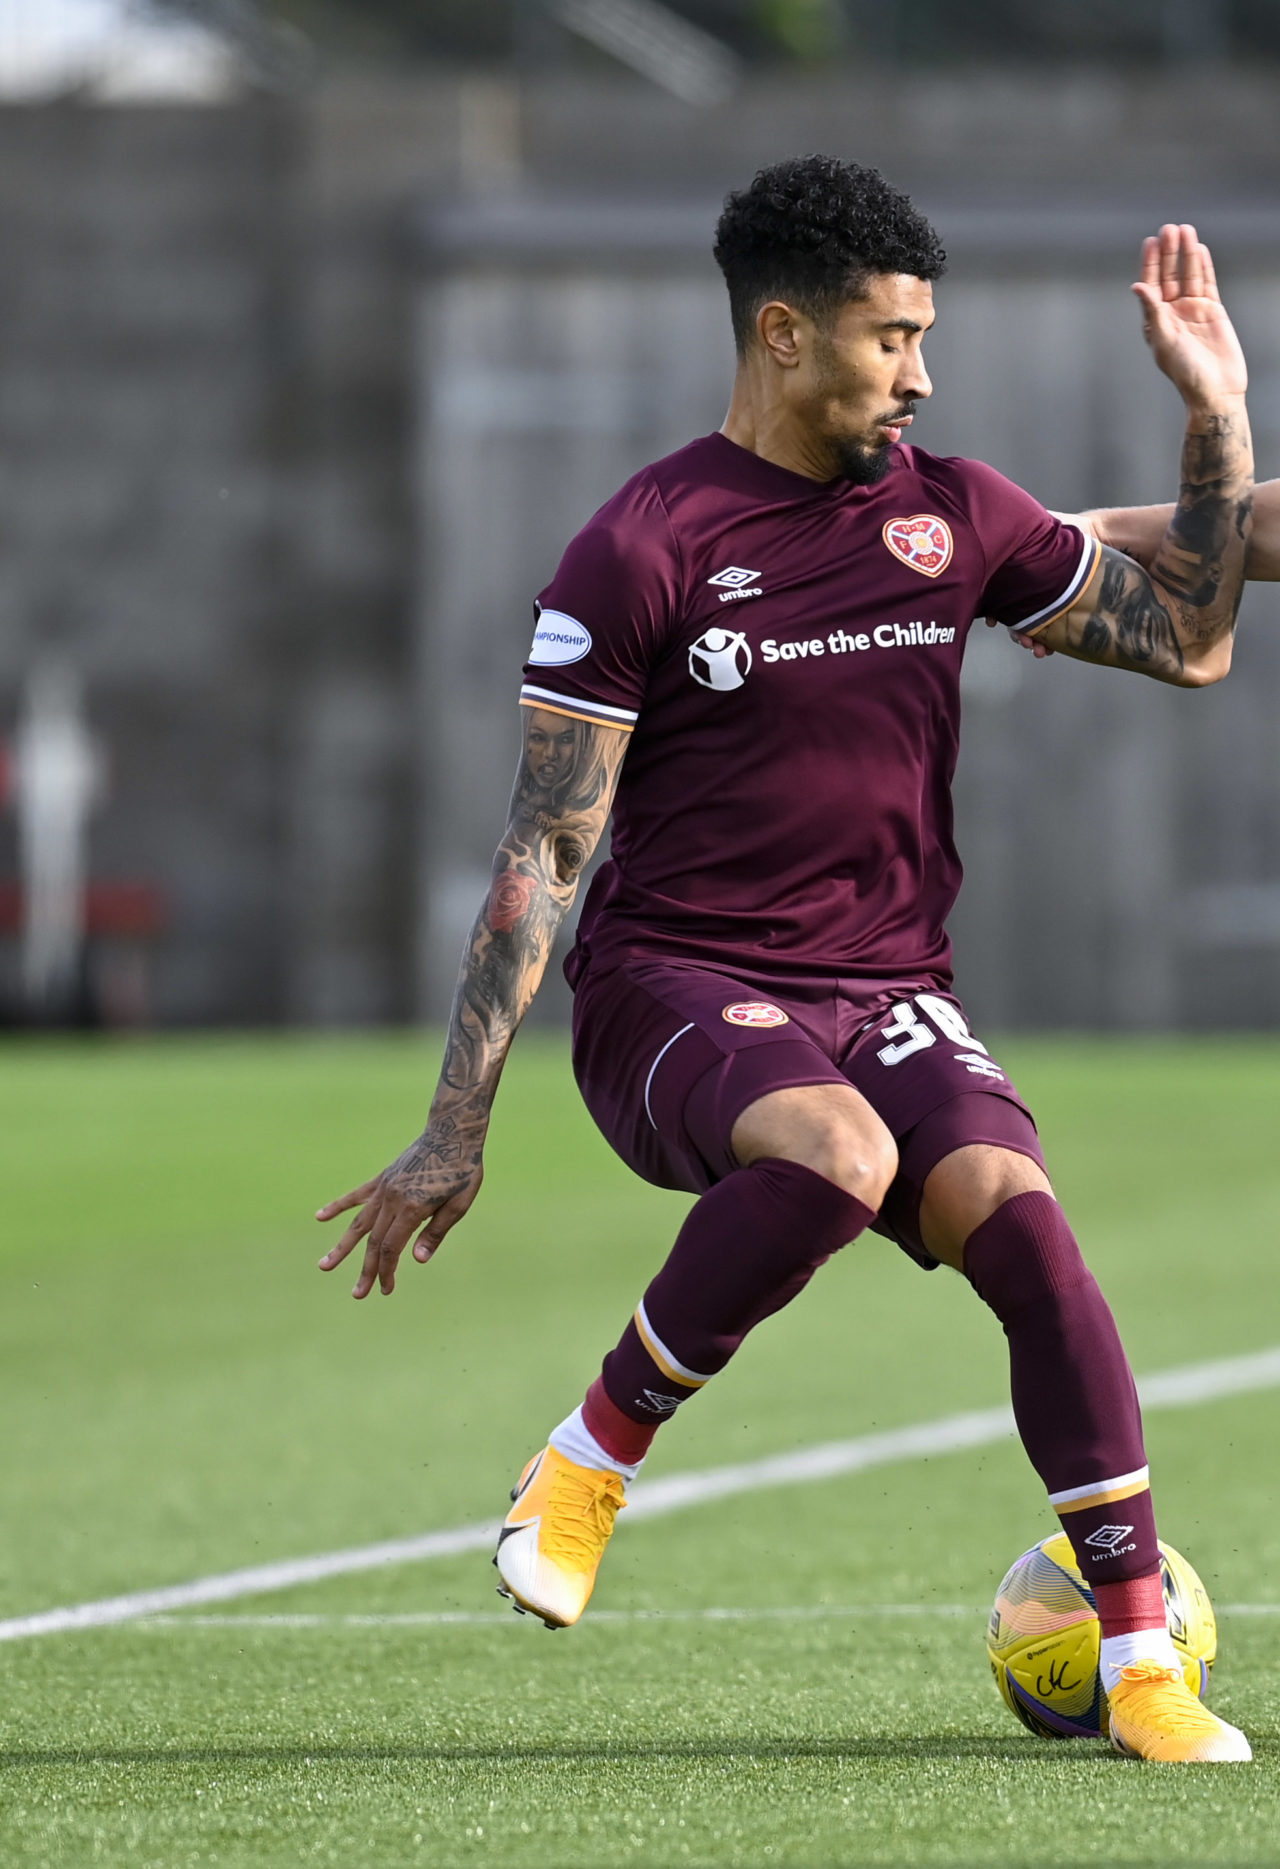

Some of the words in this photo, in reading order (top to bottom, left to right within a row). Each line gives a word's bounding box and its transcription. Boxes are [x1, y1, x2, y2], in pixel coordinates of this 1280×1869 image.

[718, 587, 763, 602] umbro
[760, 638, 825, 663] Save
[827, 629, 871, 654] the
[873, 621, 956, 648] Children
[1092, 1543, 1137, 1561] umbro
